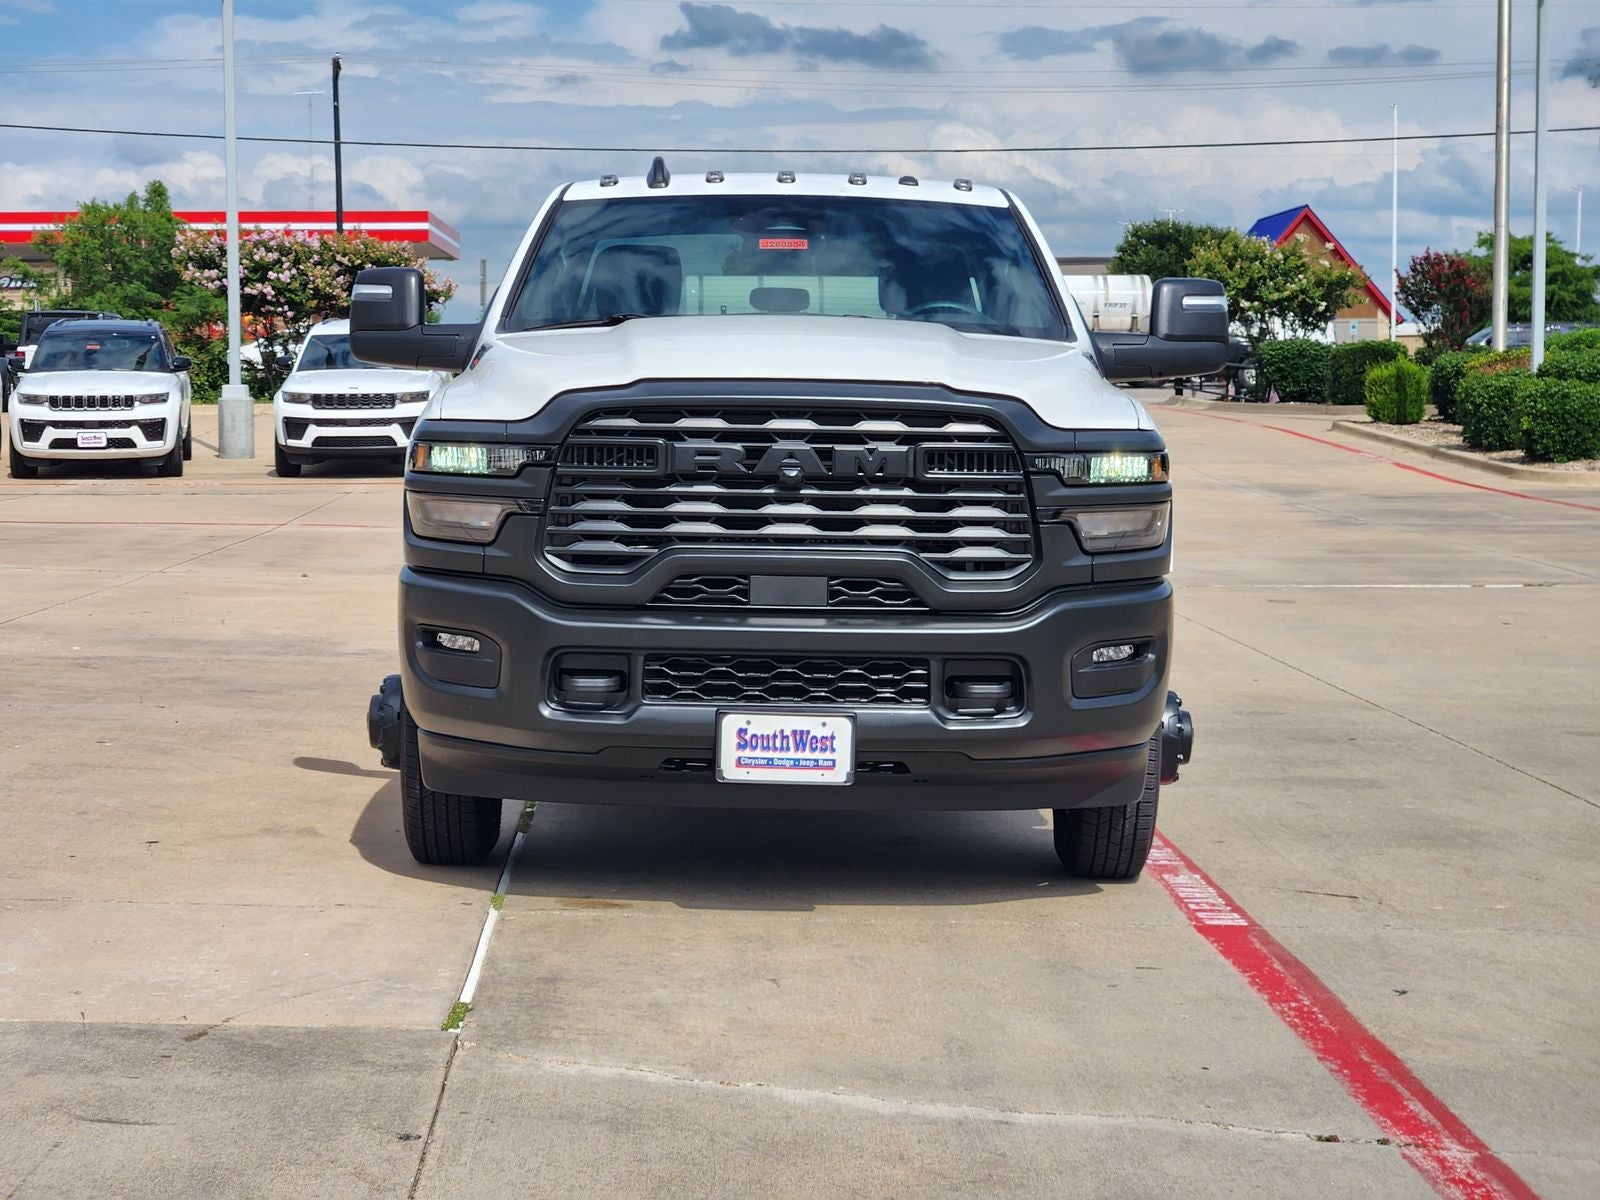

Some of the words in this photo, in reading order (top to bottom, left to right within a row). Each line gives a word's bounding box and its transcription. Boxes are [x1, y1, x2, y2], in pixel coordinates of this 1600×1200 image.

[672, 442, 914, 476] RAM
[735, 727, 836, 753] SouthWest
[740, 757, 768, 766] Chrysler
[773, 758, 795, 767] Dodge
[799, 759, 815, 767] Jeep
